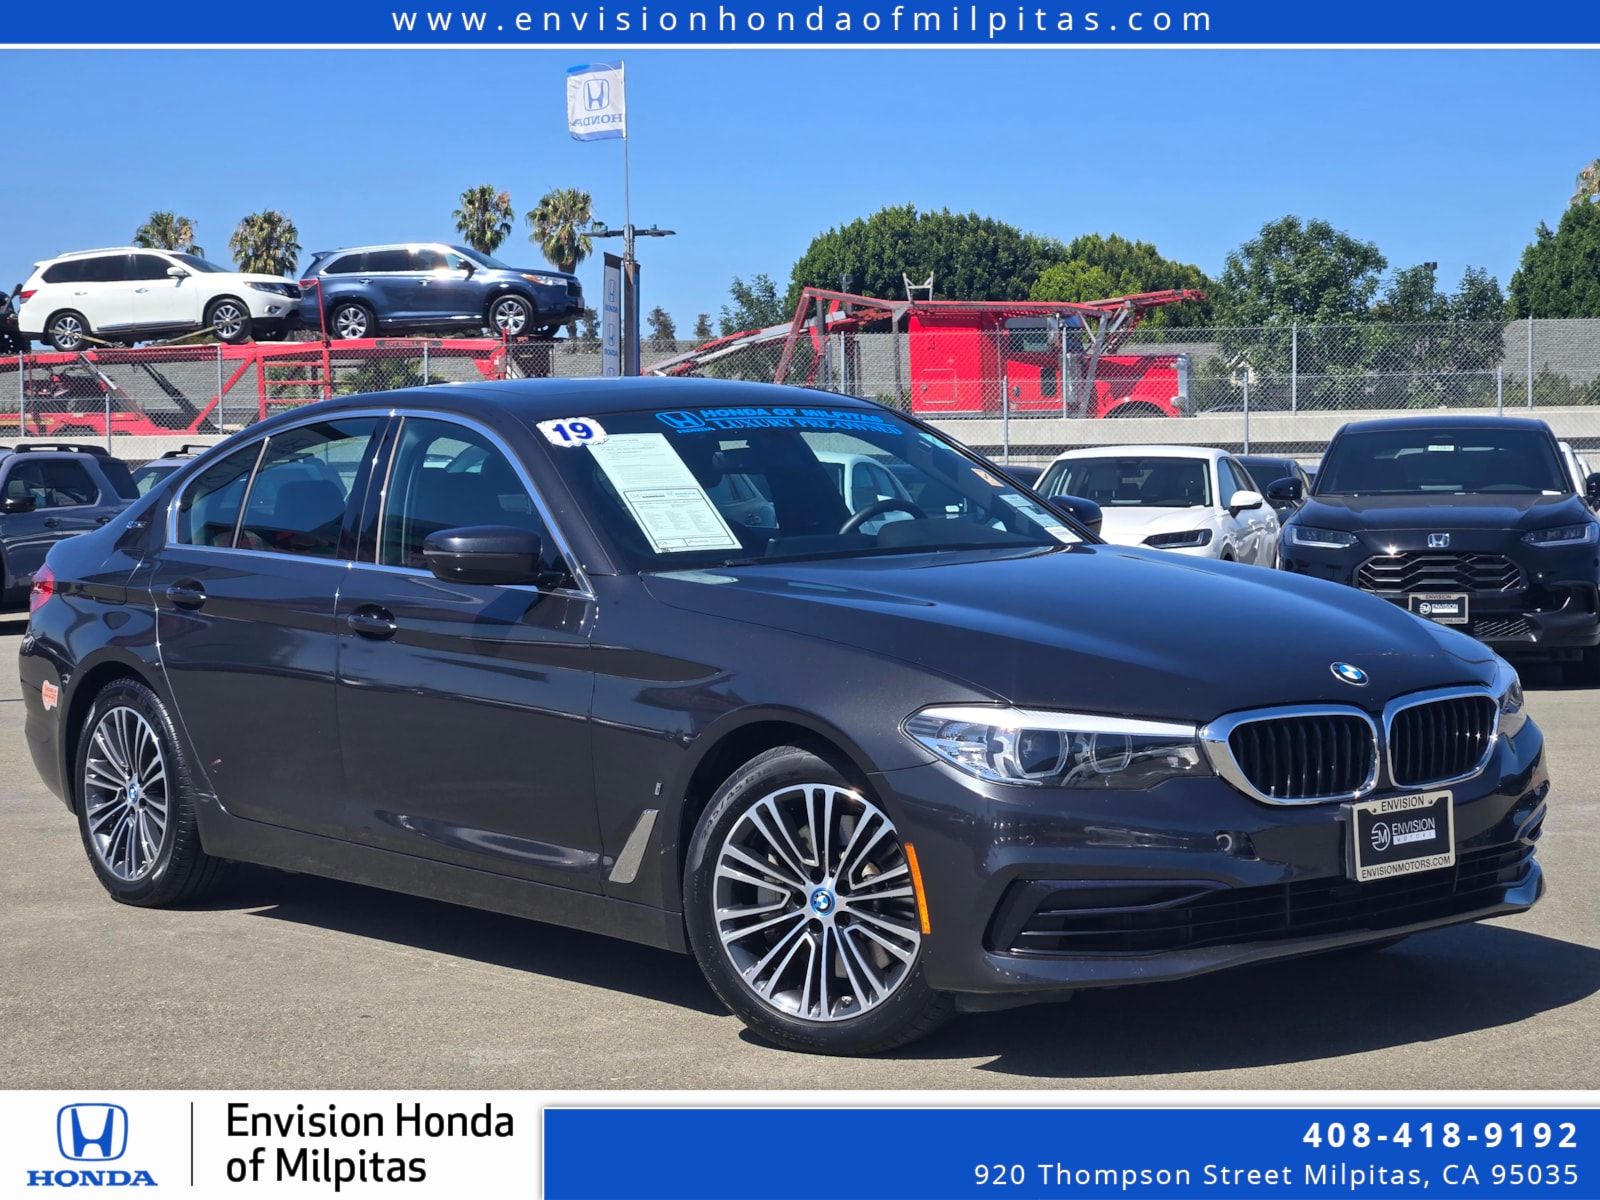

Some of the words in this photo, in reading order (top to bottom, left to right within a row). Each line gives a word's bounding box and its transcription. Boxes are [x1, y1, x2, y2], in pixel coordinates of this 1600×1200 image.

[700, 408, 771, 417] HONDA
[772, 408, 797, 416] OF
[800, 409, 884, 423] MILPITAS
[714, 419, 794, 429] LUXURY
[552, 422, 593, 441] 19
[1381, 795, 1425, 812] ENVISION
[1392, 817, 1436, 836] ENVISION
[1361, 855, 1451, 879] ENVISIONMOTORS.COM
